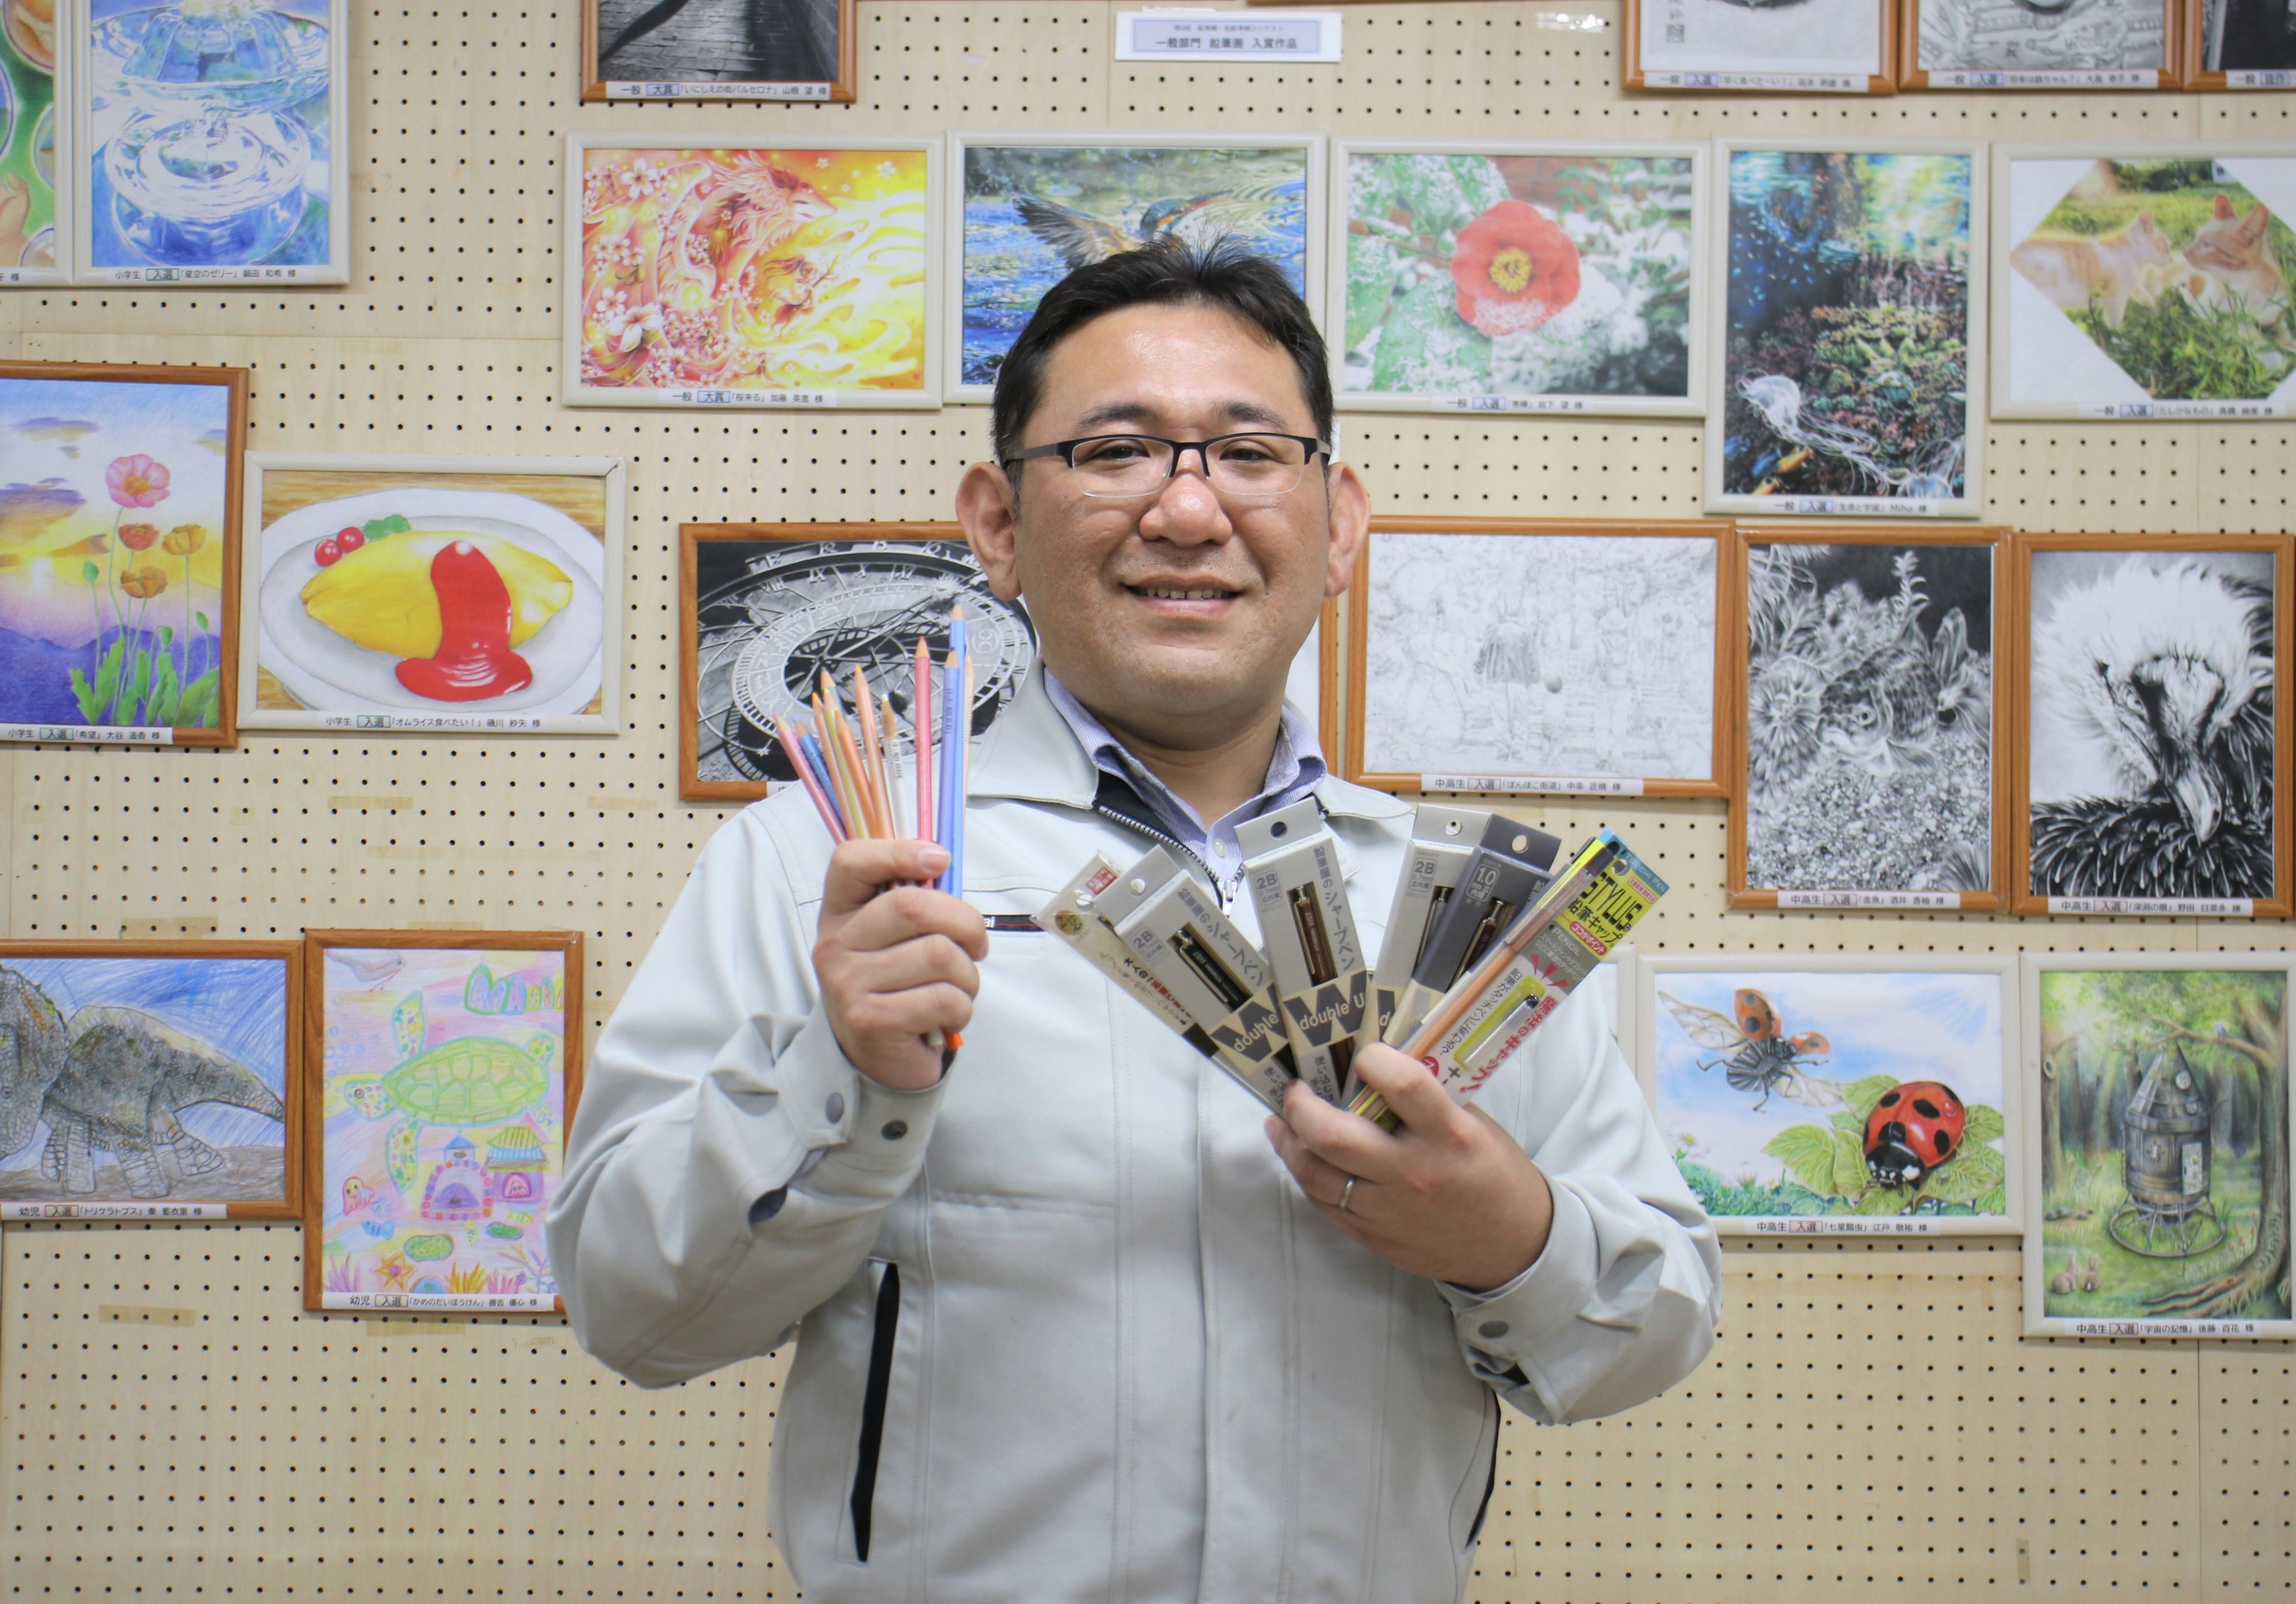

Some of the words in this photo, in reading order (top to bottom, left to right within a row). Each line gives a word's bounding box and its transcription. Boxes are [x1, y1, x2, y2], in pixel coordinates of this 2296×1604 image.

[1156, 38, 1201, 48] 一般部門
[1209, 38, 1243, 49] 鉛筆画
[1253, 38, 1297, 49] 入賞作品
[1661, 75, 1679, 84] 一般
[1945, 75, 1964, 84] 一般
[2235, 74, 2255, 84] 一般
[621, 86, 640, 95] 一般
[653, 85, 672, 95] 大賞
[115, 270, 140, 280] 小学生
[155, 269, 172, 280] 入選
[672, 392, 692, 402] 一般
[705, 392, 723, 402] 大賞
[771, 394, 787, 402] 加藤
[1448, 399, 1466, 408] 一般
[1481, 399, 1499, 409] 入選
[2095, 407, 2114, 415] 一般
[2128, 406, 2147, 416] 入選
[1775, 502, 1794, 510] 一般
[1807, 501, 1826, 512] 入選
[326, 717, 351, 725] 小学生
[365, 717, 384, 727] 入選
[9, 730, 34, 738] 小学生
[47, 730, 66, 740] 入選
[76, 731, 100, 740] 「希望」
[107, 732, 122, 740] 大谷
[1435, 779, 1465, 788] 中高生
[1475, 780, 1494, 789] 入選
[1414, 861, 1435, 874] 2B
[1412, 874, 1432, 882] 0.7mm
[1475, 866, 1497, 886] 1.0
[1256, 874, 1277, 890] 2B
[1653, 879, 1666, 892] PEN
[1258, 886, 1280, 898] 0.7mm
[1791, 895, 1820, 905] 中高生
[1830, 895, 1850, 906] 入選
[1859, 896, 1884, 905] 「金魚」
[2061, 901, 2091, 911] 中高生
[2102, 901, 2120, 912] 入選
[1132, 930, 1153, 948] 2B
[1552, 927, 1580, 956] PENCIL
[1571, 922, 1607, 954] ココがポイント
[1300, 1002, 1350, 1031] double
[1353, 993, 1365, 1009] U
[1234, 1013, 1279, 1052] double
[19, 1207, 40, 1216] 幼児
[53, 1206, 72, 1216] 入選
[1757, 1222, 1787, 1232] 中高生
[1798, 1222, 1816, 1232] 入選
[1919, 1223, 1927, 1232] 様
[350, 1295, 370, 1305] 幼児
[382, 1295, 402, 1306] 入選
[410, 1297, 483, 1307] 「かめのだいぼうけん」
[530, 1298, 537, 1307] 様
[2077, 1324, 2107, 1334] 中高生
[2114, 1324, 2134, 1335] 入選
[2140, 1324, 2191, 1334] 「宇宙の記憶」
[2199, 1324, 2215, 1333] 後藤
[2222, 1324, 2239, 1333] 百花
[2246, 1324, 2254, 1333] 様
